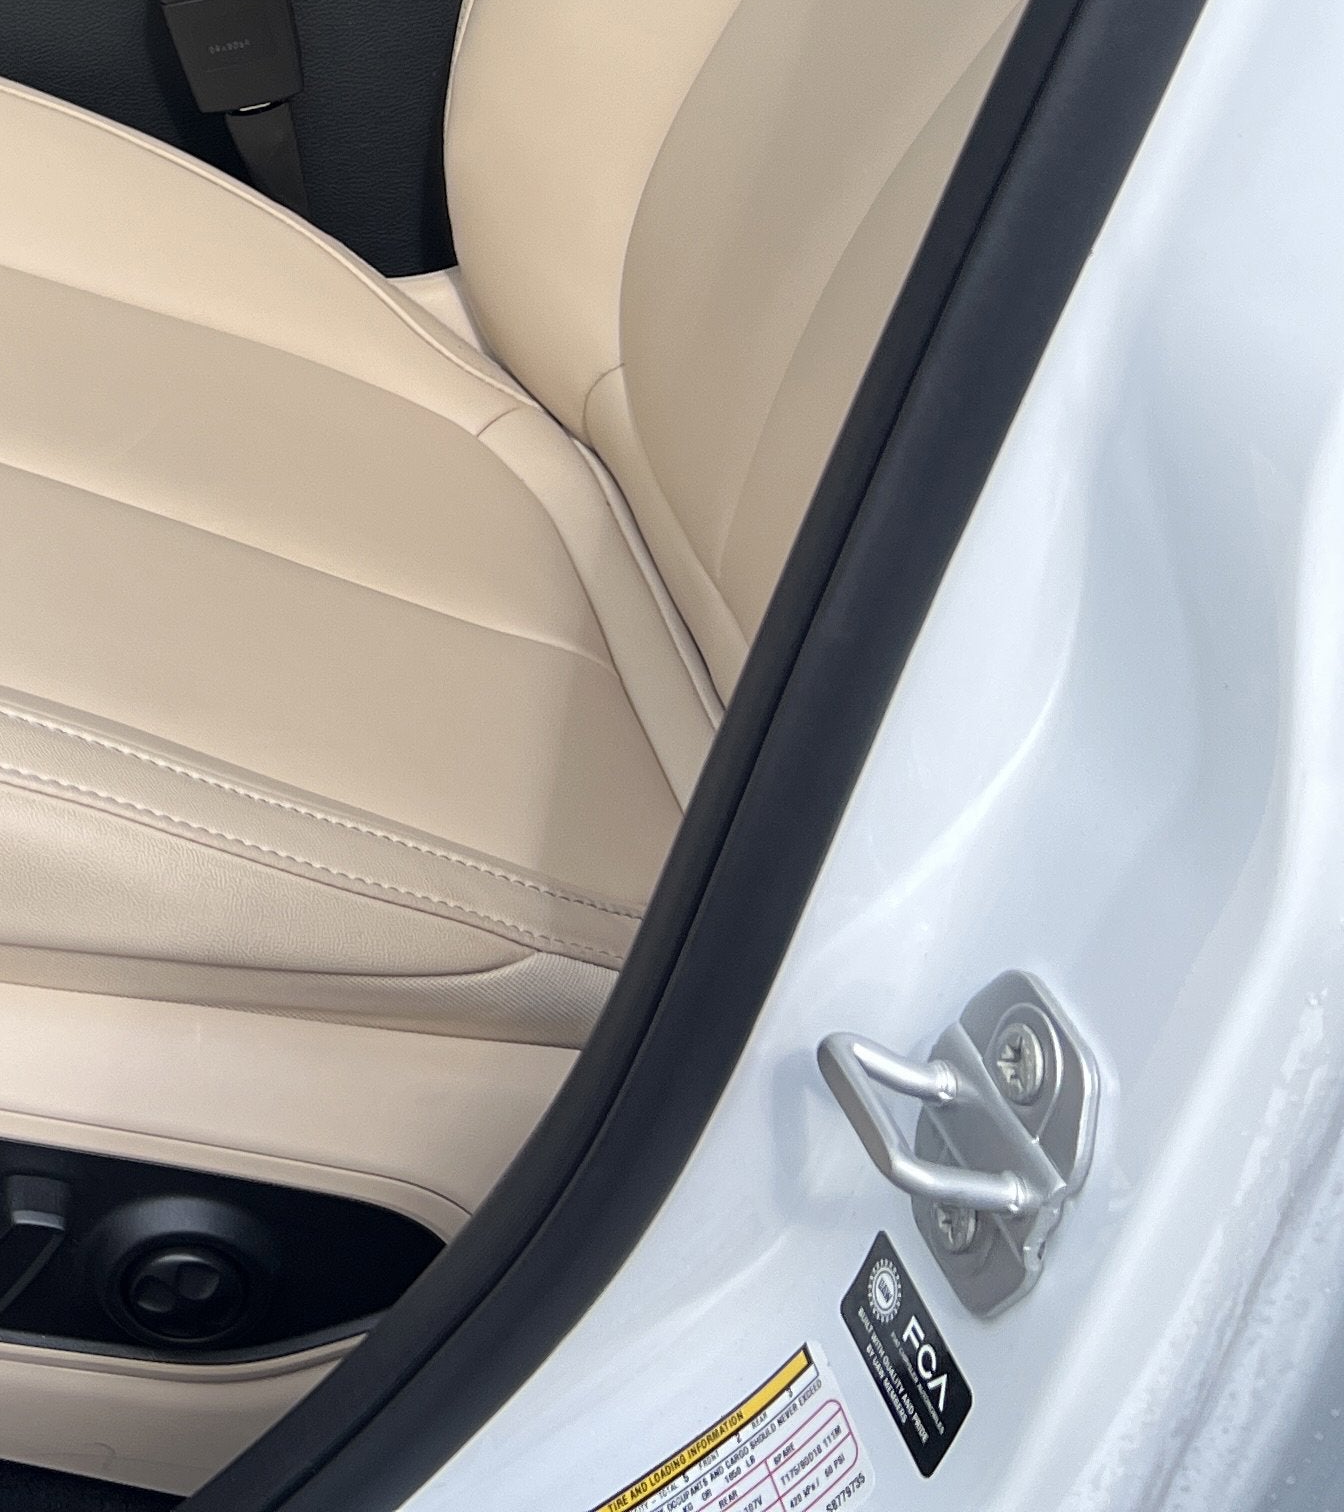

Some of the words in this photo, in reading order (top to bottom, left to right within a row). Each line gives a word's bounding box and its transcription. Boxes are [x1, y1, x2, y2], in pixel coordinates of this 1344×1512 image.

[858, 1306, 874, 1333] BUILT
[871, 1331, 885, 1357] WITH
[882, 1355, 905, 1394] QUALITY
[901, 1393, 915, 1415] AND
[912, 1412, 929, 1445] PRIDE
[866, 1343, 875, 1357] BY
[883, 1377, 908, 1424] MEMBERS
[899, 1347, 919, 1384] CHRYSLER
[902, 1315, 948, 1412] FCA
[605, 1497, 628, 1512] TIRE
[630, 1481, 648, 1500] AND
[649, 1455, 687, 1487] LOADING
[687, 1409, 744, 1460] INFORMATION
[666, 1477, 709, 1512] OCCUPANTS
[710, 1466, 724, 1482] AND
[724, 1447, 749, 1470] CARGO
[749, 1424, 777, 1450] SHOULD
[777, 1404, 798, 1426] NEVER
[799, 1379, 822, 1407] EXCEED
[698, 1450, 720, 1471] FRONT
[751, 1411, 768, 1430] REAR
[701, 1488, 712, 1502] OR
[745, 1454, 756, 1468] LB
[718, 1489, 739, 1510] REAR
[773, 1442, 796, 1466] SPARE
[833, 1453, 846, 1469] PSI
